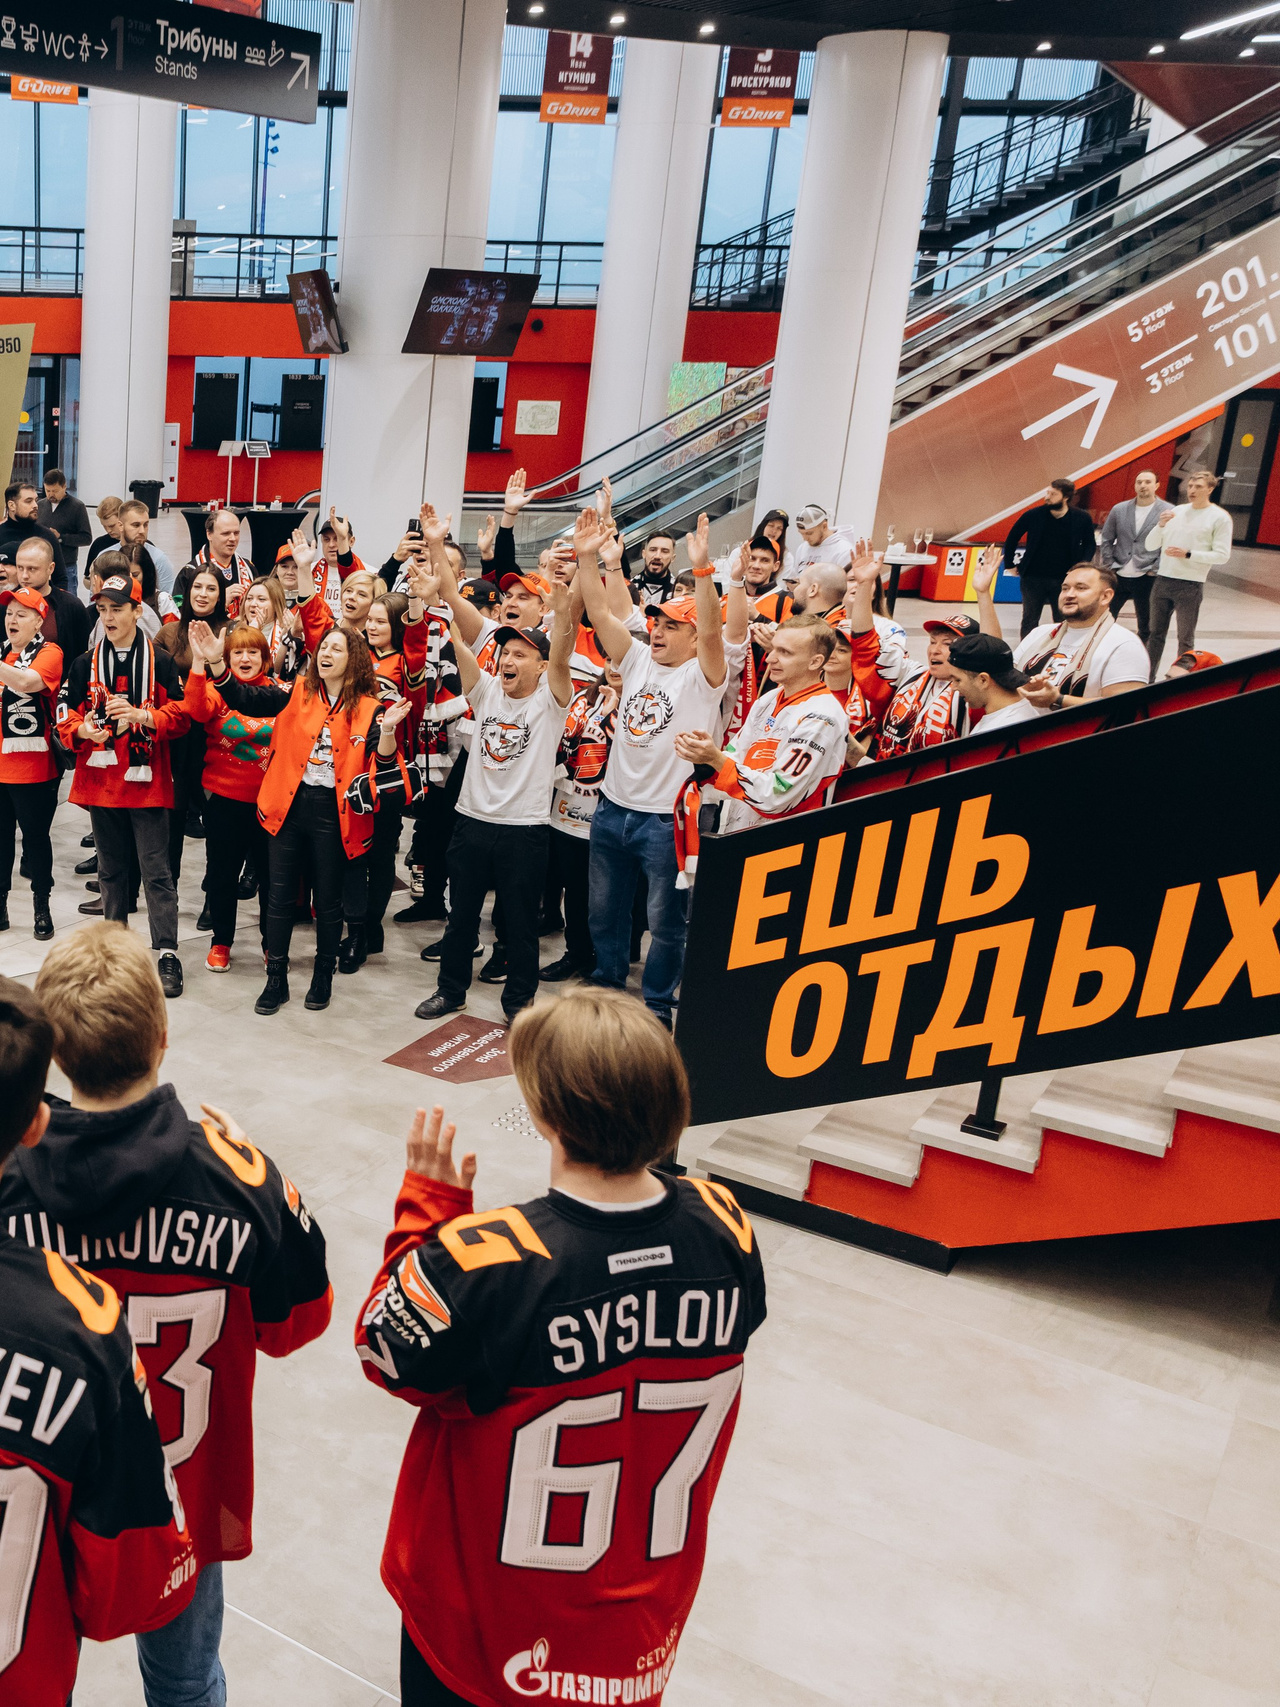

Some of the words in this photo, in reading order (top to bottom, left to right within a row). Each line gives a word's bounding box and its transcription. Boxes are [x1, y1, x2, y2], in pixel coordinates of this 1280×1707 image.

[42, 31, 75, 60] WC
[156, 19, 237, 62] Трибуны
[570, 32, 593, 57] 14
[155, 55, 198, 80] Stands
[558, 71, 596, 84] ИГУМНОВ
[730, 76, 792, 88] ПРОСКУРЯКОВ
[1127, 321, 1143, 343] 5
[1141, 301, 1175, 326] этаж
[1145, 318, 1166, 335] floor
[1146, 372, 1162, 394] 3
[1160, 353, 1194, 378] этаж
[781, 748, 813, 777] 70
[727, 794, 1030, 970] ЕШЬ
[765, 870, 1280, 1080] ОТДЫХ
[428, 1032, 470, 1057] питания
[475, 1047, 506, 1064] Зона
[615, 1251, 666, 1267] ТИНЬКОФФ
[548, 1287, 739, 1373] SYSLOV
[499, 1363, 744, 1572] 67
[637, 1647, 667, 1671] СЕТЬ
